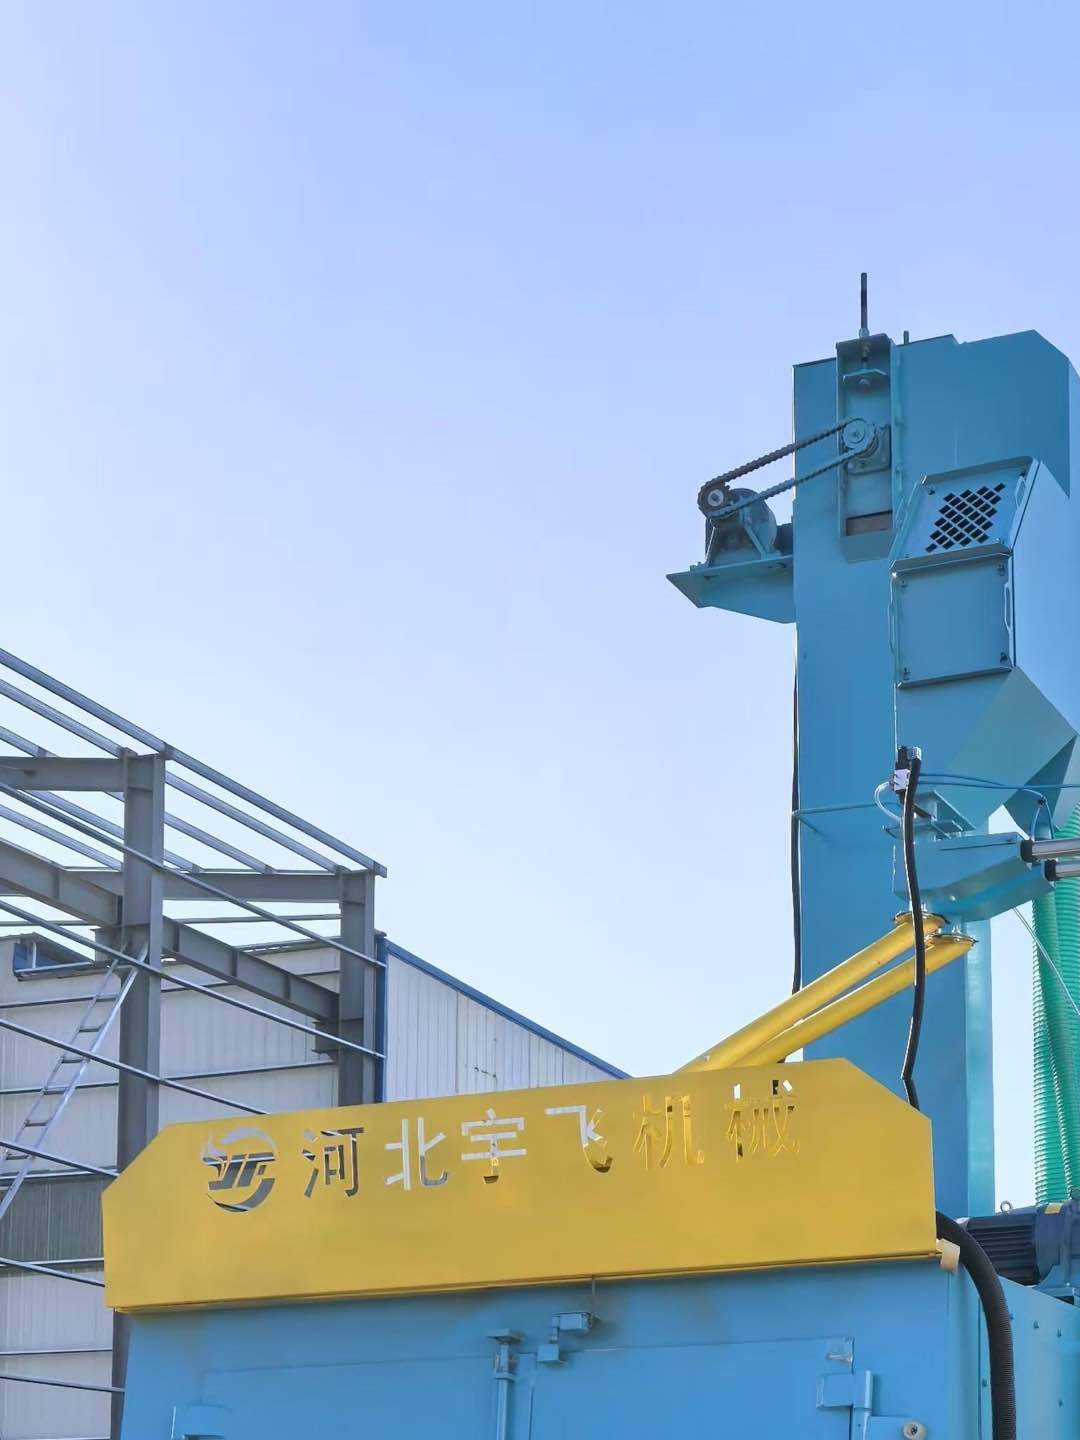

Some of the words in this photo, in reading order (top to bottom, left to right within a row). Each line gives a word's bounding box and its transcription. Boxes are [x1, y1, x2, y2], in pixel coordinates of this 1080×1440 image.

[302, 1079, 800, 1198] 河北宇飞机械
